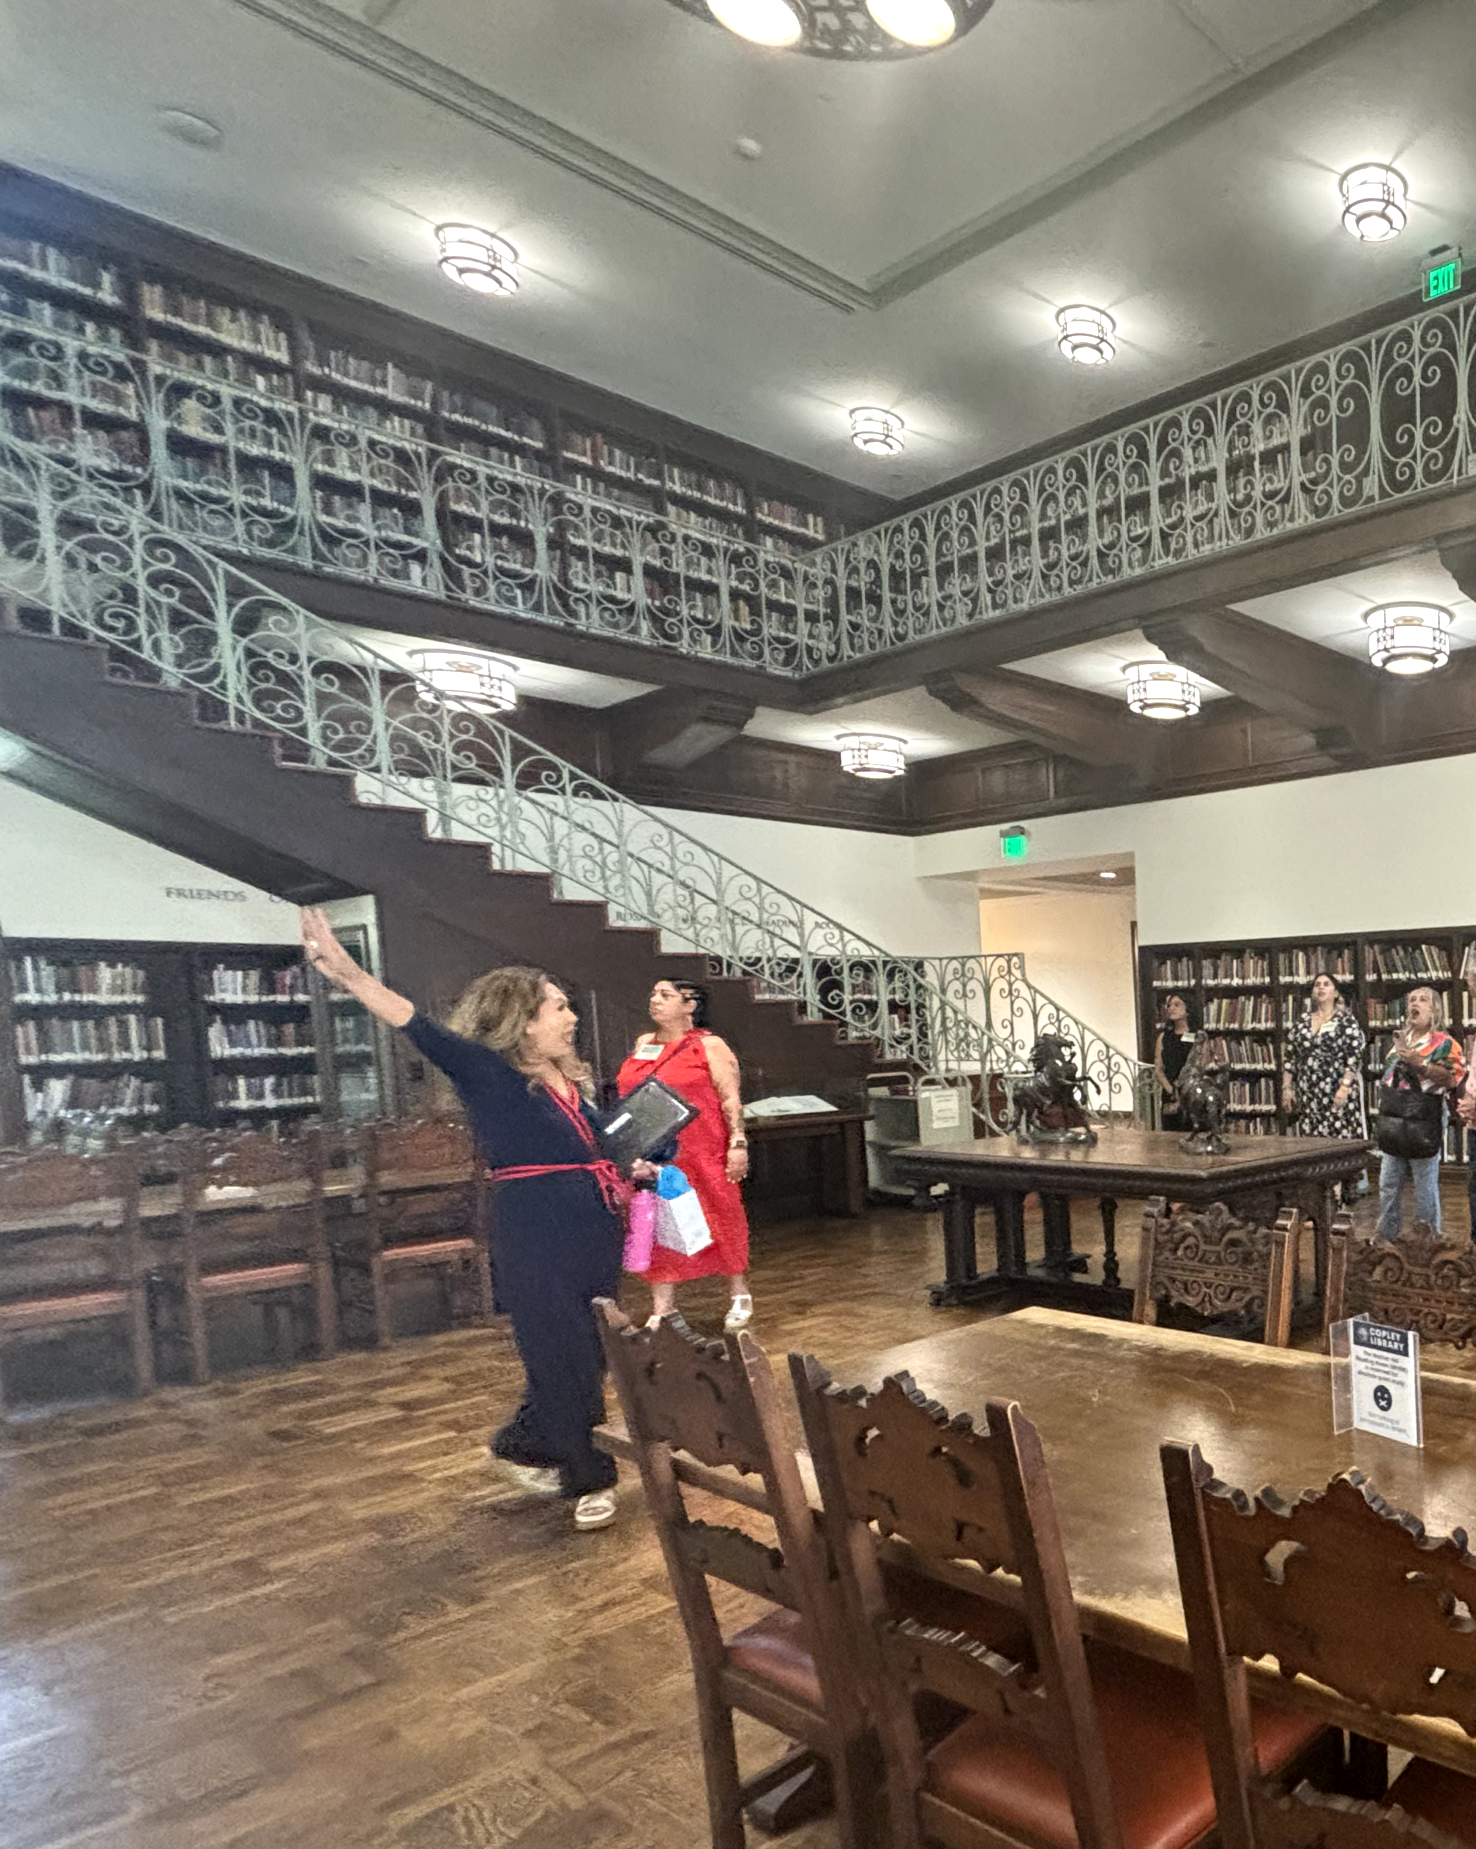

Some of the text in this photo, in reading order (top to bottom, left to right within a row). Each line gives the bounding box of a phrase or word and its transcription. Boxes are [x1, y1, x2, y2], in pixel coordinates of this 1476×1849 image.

[1429, 263, 1456, 297] EXIT
[165, 887, 247, 902] FRIENDS
[1370, 1327, 1401, 1341] COPLEY
[1370, 1337, 1404, 1352] LIBRARY
